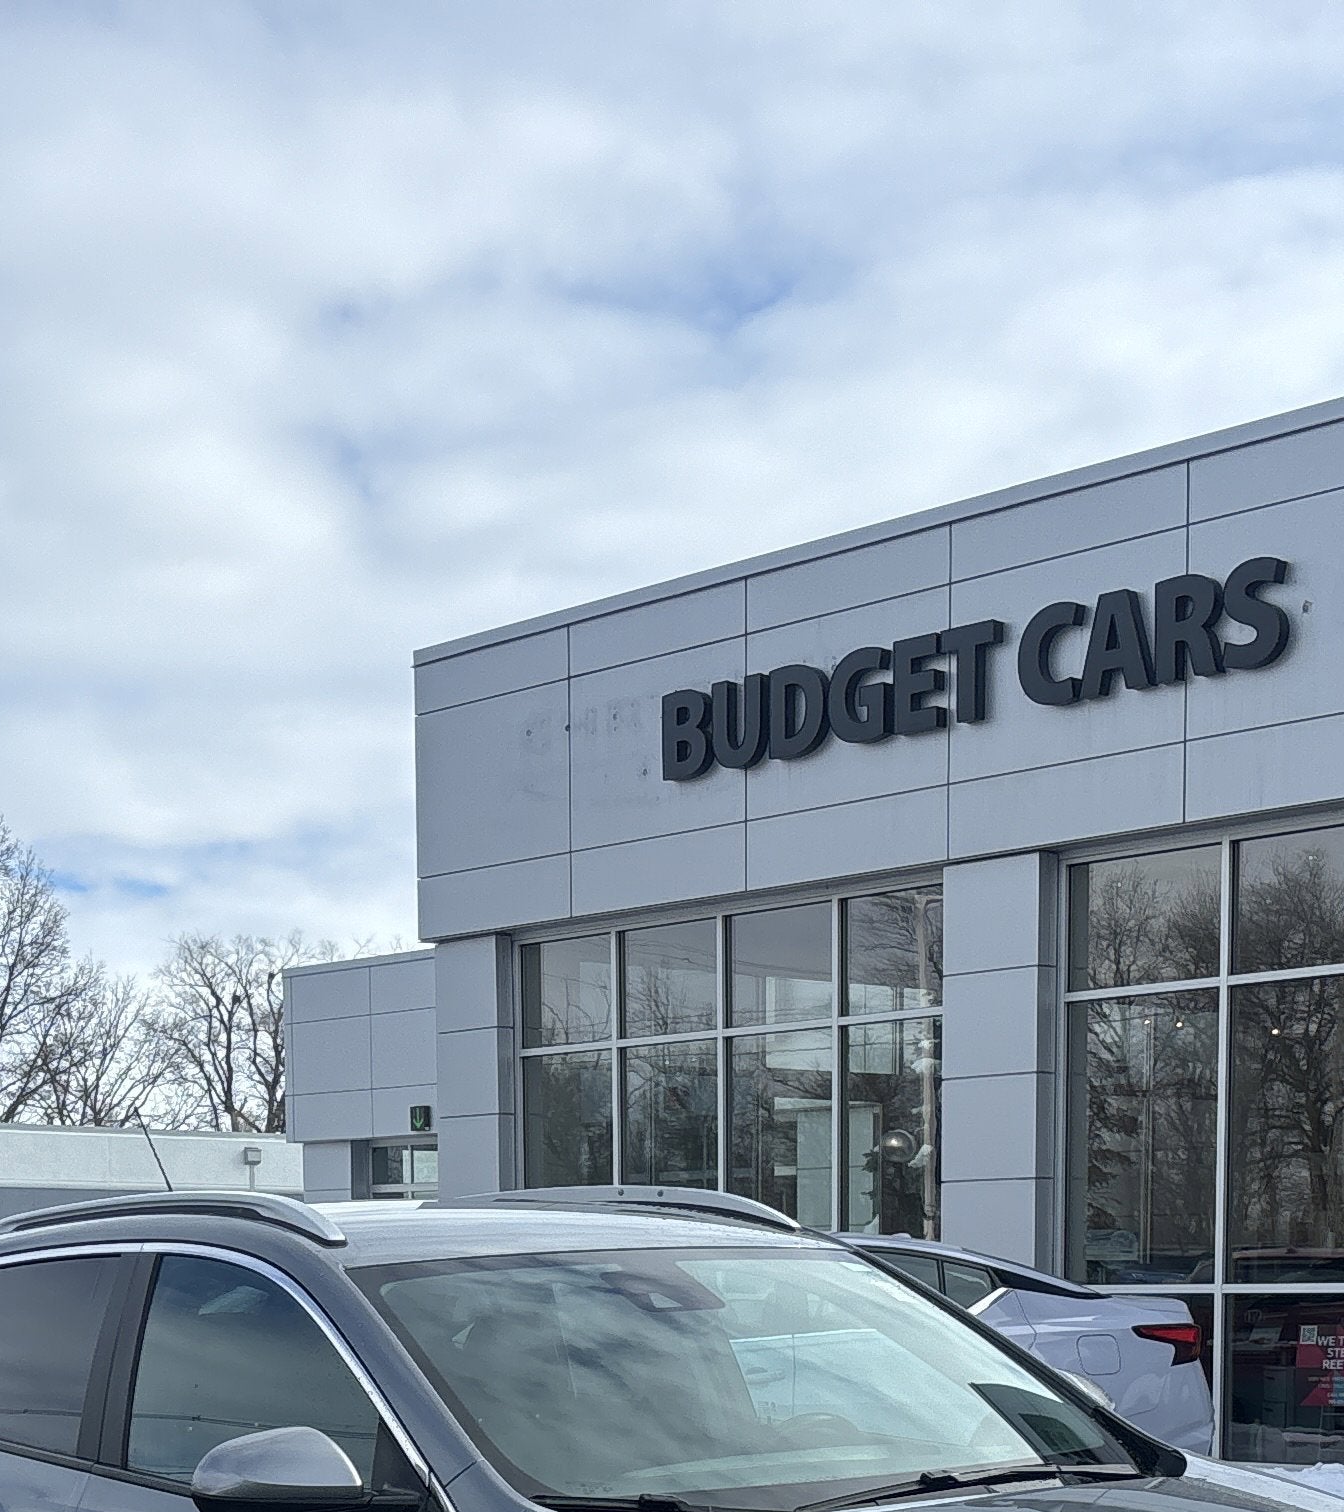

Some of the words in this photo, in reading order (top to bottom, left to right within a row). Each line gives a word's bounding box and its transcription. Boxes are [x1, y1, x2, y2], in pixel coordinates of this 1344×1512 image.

[663, 619, 1004, 782] BUDGET
[1018, 557, 1290, 706] CARS
[1317, 1335, 1336, 1347] WE
